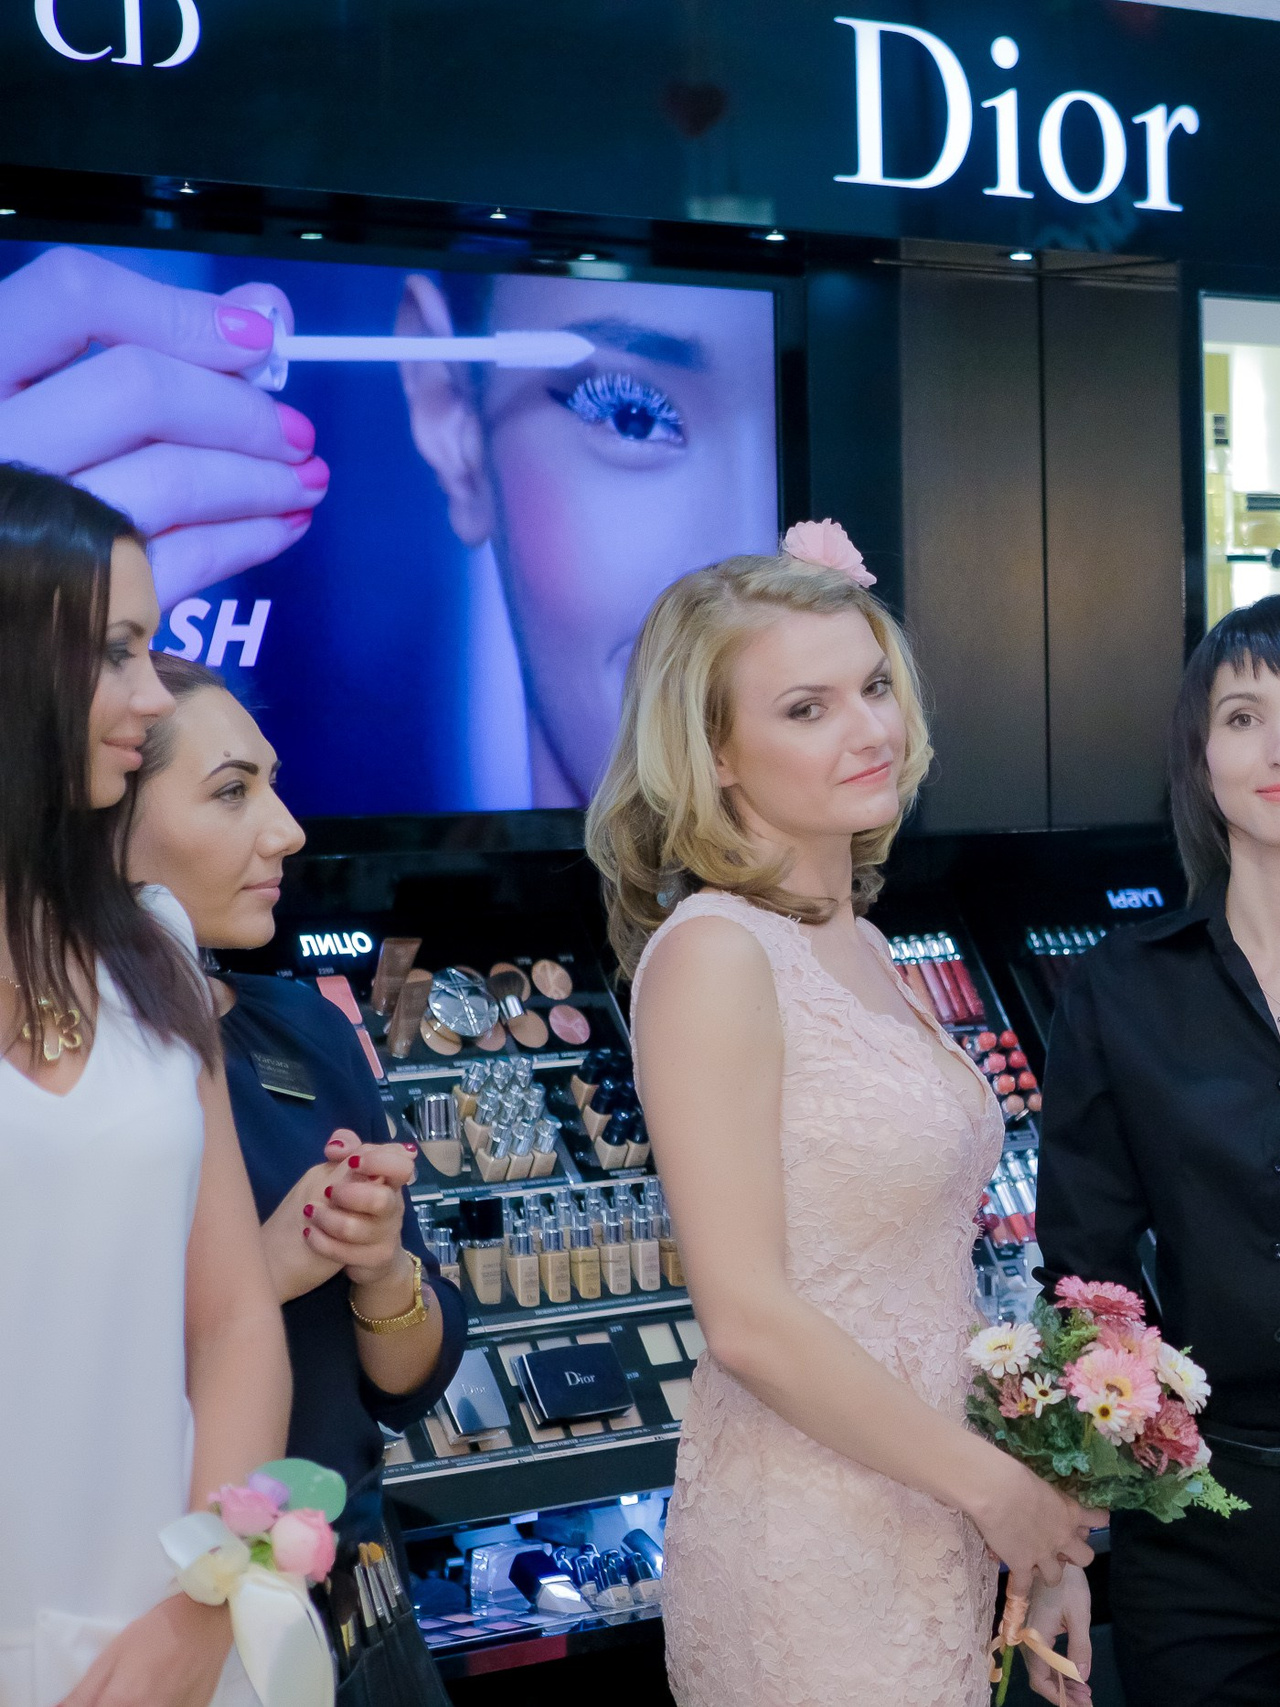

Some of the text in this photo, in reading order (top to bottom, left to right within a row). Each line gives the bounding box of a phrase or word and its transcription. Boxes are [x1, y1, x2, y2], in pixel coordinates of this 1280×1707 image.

[833, 16, 1200, 213] Dior
[299, 931, 373, 957] ЛИЦО
[564, 1371, 596, 1387] Dior
